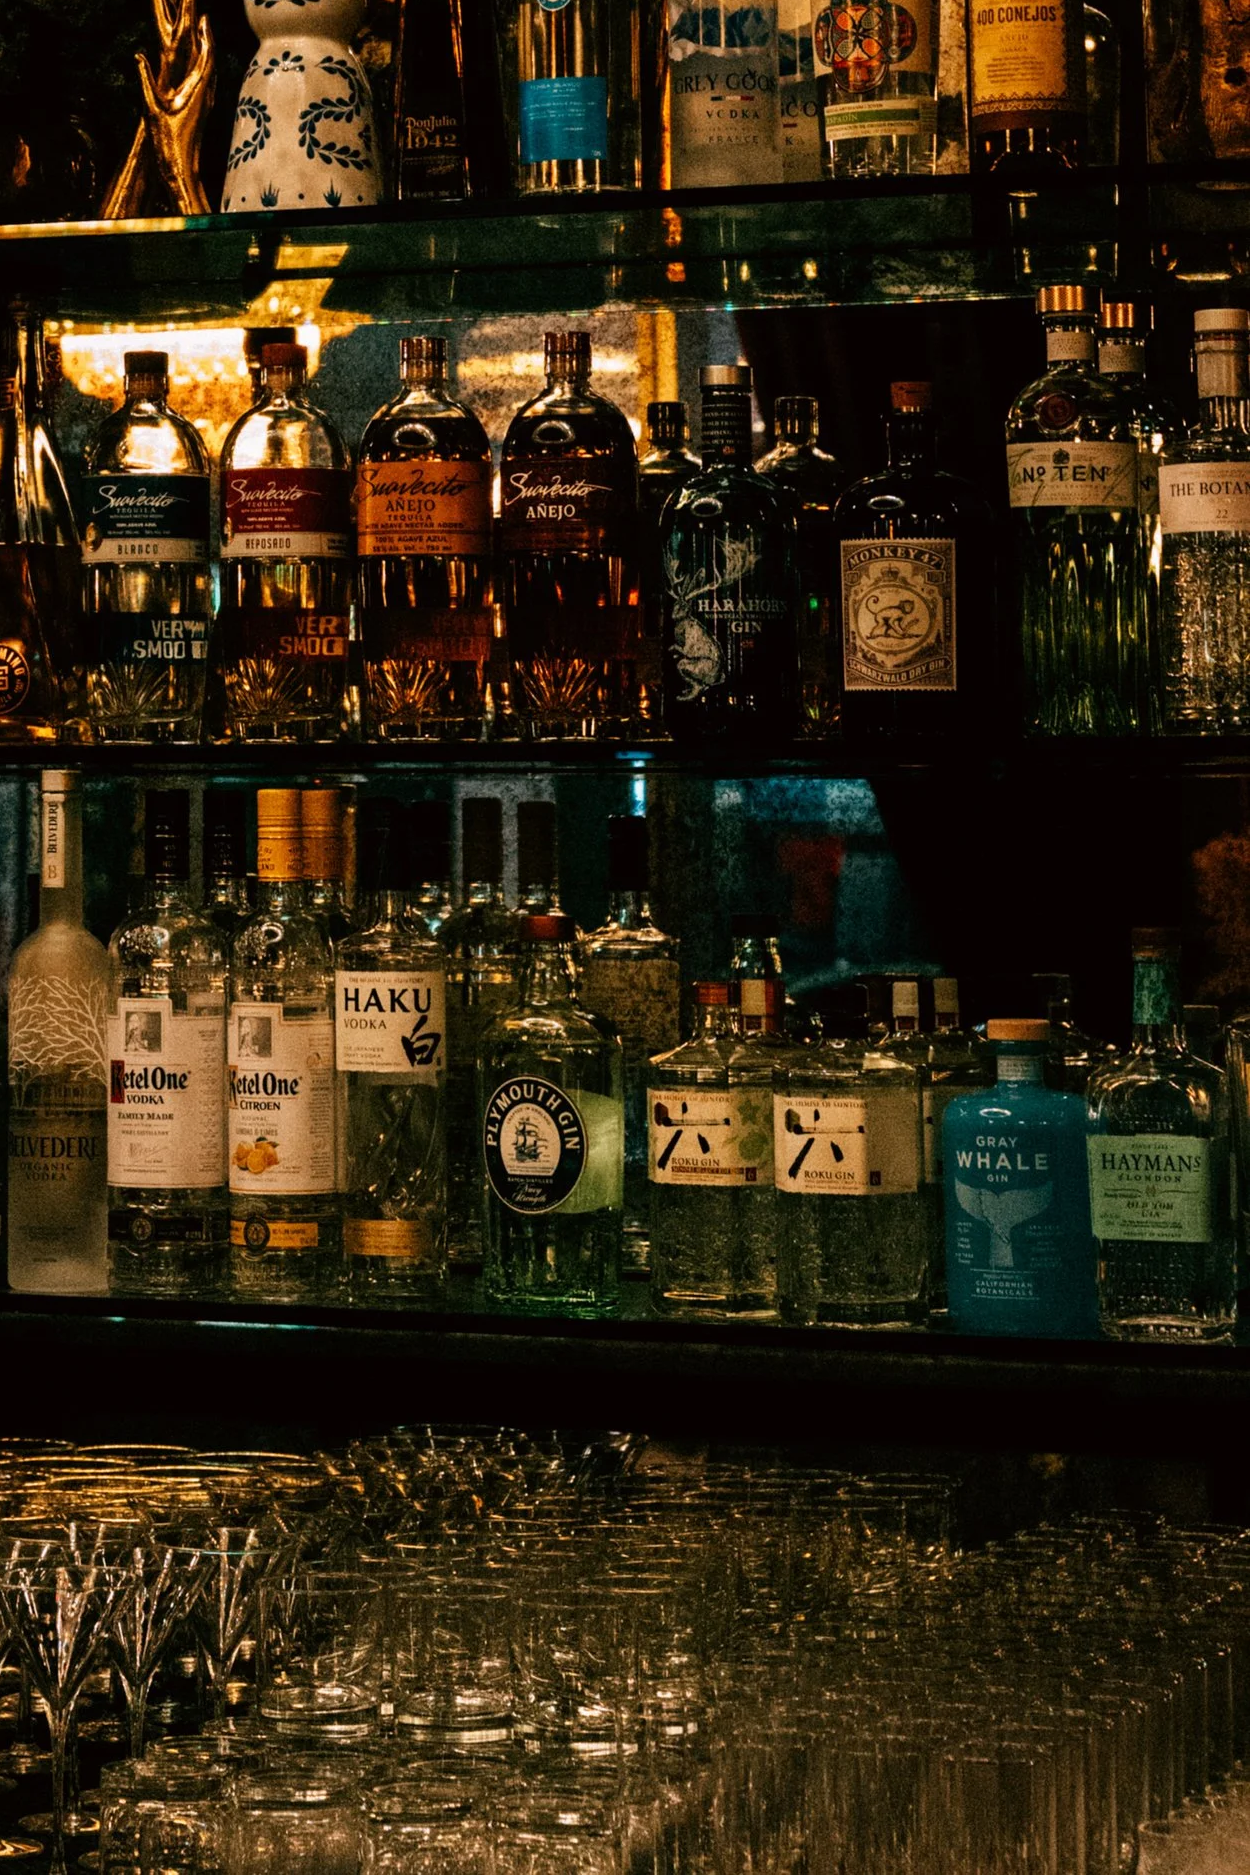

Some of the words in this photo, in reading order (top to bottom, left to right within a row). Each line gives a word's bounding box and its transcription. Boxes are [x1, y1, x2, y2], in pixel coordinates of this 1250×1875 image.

[977, 9, 994, 25] 400
[997, 6, 1056, 23] CONEJOS
[676, 73, 716, 94] GREY
[706, 110, 760, 119] VODKA
[405, 125, 460, 150] 1942
[709, 135, 758, 144] FRANCE
[1053, 466, 1107, 482] TEN
[356, 469, 482, 500] Suavecito
[505, 470, 613, 506] Suavecito
[1170, 483, 1196, 497] THE
[92, 484, 191, 514] Suavecito
[225, 477, 321, 509] Suavecito
[385, 497, 436, 512] AÑEJO
[526, 503, 576, 521] AÑEJO
[1216, 509, 1228, 519] 22
[118, 544, 158, 554] BLANCO
[245, 538, 291, 549] REPOSADO
[850, 546, 919, 566] MONKEY
[920, 552, 940, 566] 47
[731, 621, 763, 634] GIN
[850, 659, 907, 683] SCHWARZWALD
[909, 666, 928, 679] DRY
[929, 659, 946, 671] GIN
[48, 865, 57, 879] B
[344, 987, 432, 1013] HAKU
[344, 1018, 387, 1030] VODKA
[111, 1061, 148, 1103] Ketel
[151, 1066, 188, 1090] One
[228, 1066, 261, 1107] Ketel
[263, 1072, 299, 1096] One
[127, 1095, 164, 1104] VODKA
[239, 1100, 281, 1110] CITROEN
[794, 1100, 820, 1108] HOUSE
[118, 1112, 145, 1120] FAMILY
[147, 1112, 174, 1120] MADE
[486, 1084, 562, 1146] PLYMOUTH
[558, 1111, 581, 1150] GIN
[9, 1134, 100, 1161] BELVEDERE
[975, 1135, 1019, 1149] GRAY
[21, 1162, 73, 1171] ORGANIC
[671, 1157, 699, 1167] ROKU
[701, 1158, 720, 1167] GIN
[956, 1151, 1050, 1171] WHALE
[26, 1172, 68, 1181] VODKA
[804, 1170, 833, 1180] ROKU
[835, 1171, 855, 1180] GIN
[986, 1173, 1009, 1183] GIN
[1126, 1174, 1182, 1183] LONDON
[975, 1279, 1034, 1289] CALIFORNIAN
[975, 1287, 1034, 1297] BOTANICALS
